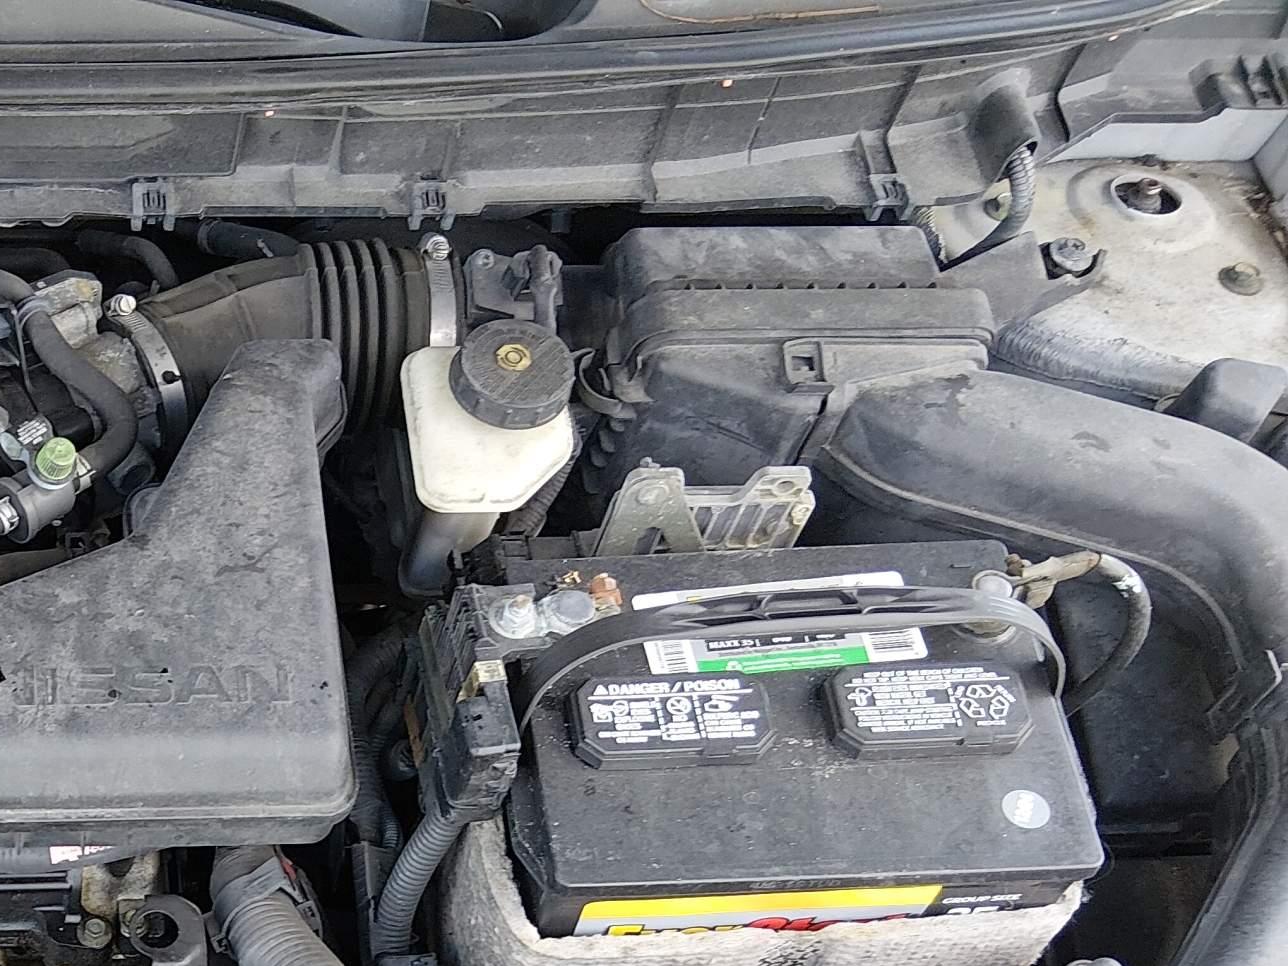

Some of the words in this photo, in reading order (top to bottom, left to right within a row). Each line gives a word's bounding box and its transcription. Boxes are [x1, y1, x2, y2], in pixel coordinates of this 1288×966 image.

[608, 683, 671, 695] DANGER
[671, 681, 682, 693] /
[683, 679, 741, 692] POISON
[942, 895, 991, 904] GROUP
[991, 893, 1024, 902] SIZE
